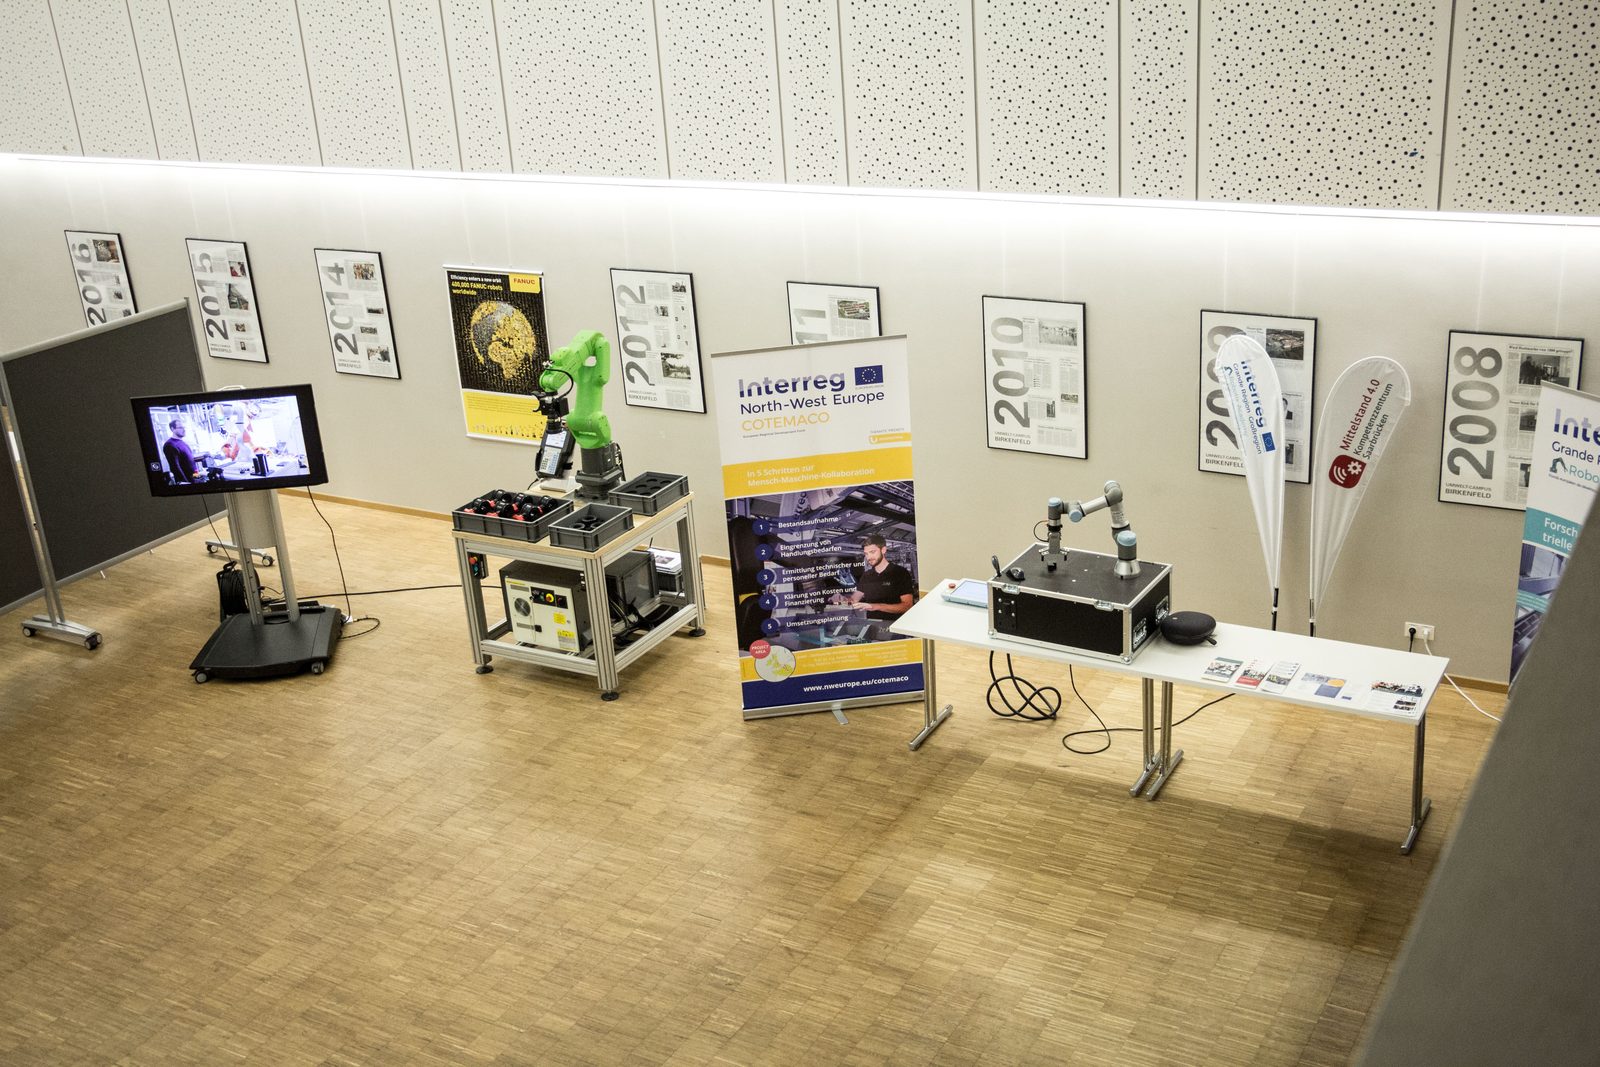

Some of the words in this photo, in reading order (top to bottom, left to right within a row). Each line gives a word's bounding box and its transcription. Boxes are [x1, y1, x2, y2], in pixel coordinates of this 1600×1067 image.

[72, 242, 107, 326] 2016
[192, 253, 229, 340] 2015
[321, 262, 358, 355] 2014
[616, 284, 655, 386] 2012
[991, 317, 1030, 428] 2010
[738, 372, 846, 398] Interreg
[741, 395, 827, 415] North-West
[833, 390, 885, 406] Europe
[741, 411, 830, 432] COTEMACO
[1340, 395, 1372, 450] Mittelstand
[1367, 379, 1380, 394] 4.0
[1353, 383, 1393, 455] Kompetenzzentrum
[1447, 346, 1502, 480] 2008
[1362, 414, 1389, 459] Saarbrücken
[1552, 441, 1594, 463] Grande
[747, 468, 875, 487] Mensch-Maschine-Kollaboration
[763, 466, 800, 476] Schritten
[1445, 488, 1491, 498] BIRKENFELD
[778, 516, 838, 528] Bestandsaufnahme
[1544, 517, 1578, 537] Forsch
[780, 542, 818, 551] Eingrenzung
[780, 546, 842, 557] Handlungsbedarfen
[1542, 532, 1573, 551] trielle
[782, 566, 815, 575] Ermittlung
[816, 562, 851, 572] technischer
[782, 573, 818, 583] personeller
[784, 592, 808, 600] Klärung
[784, 597, 824, 607] Finanzierung
[786, 615, 848, 628] Umsetzungsplanung
[803, 675, 909, 692] www.nweurope.eu/cotemaco
